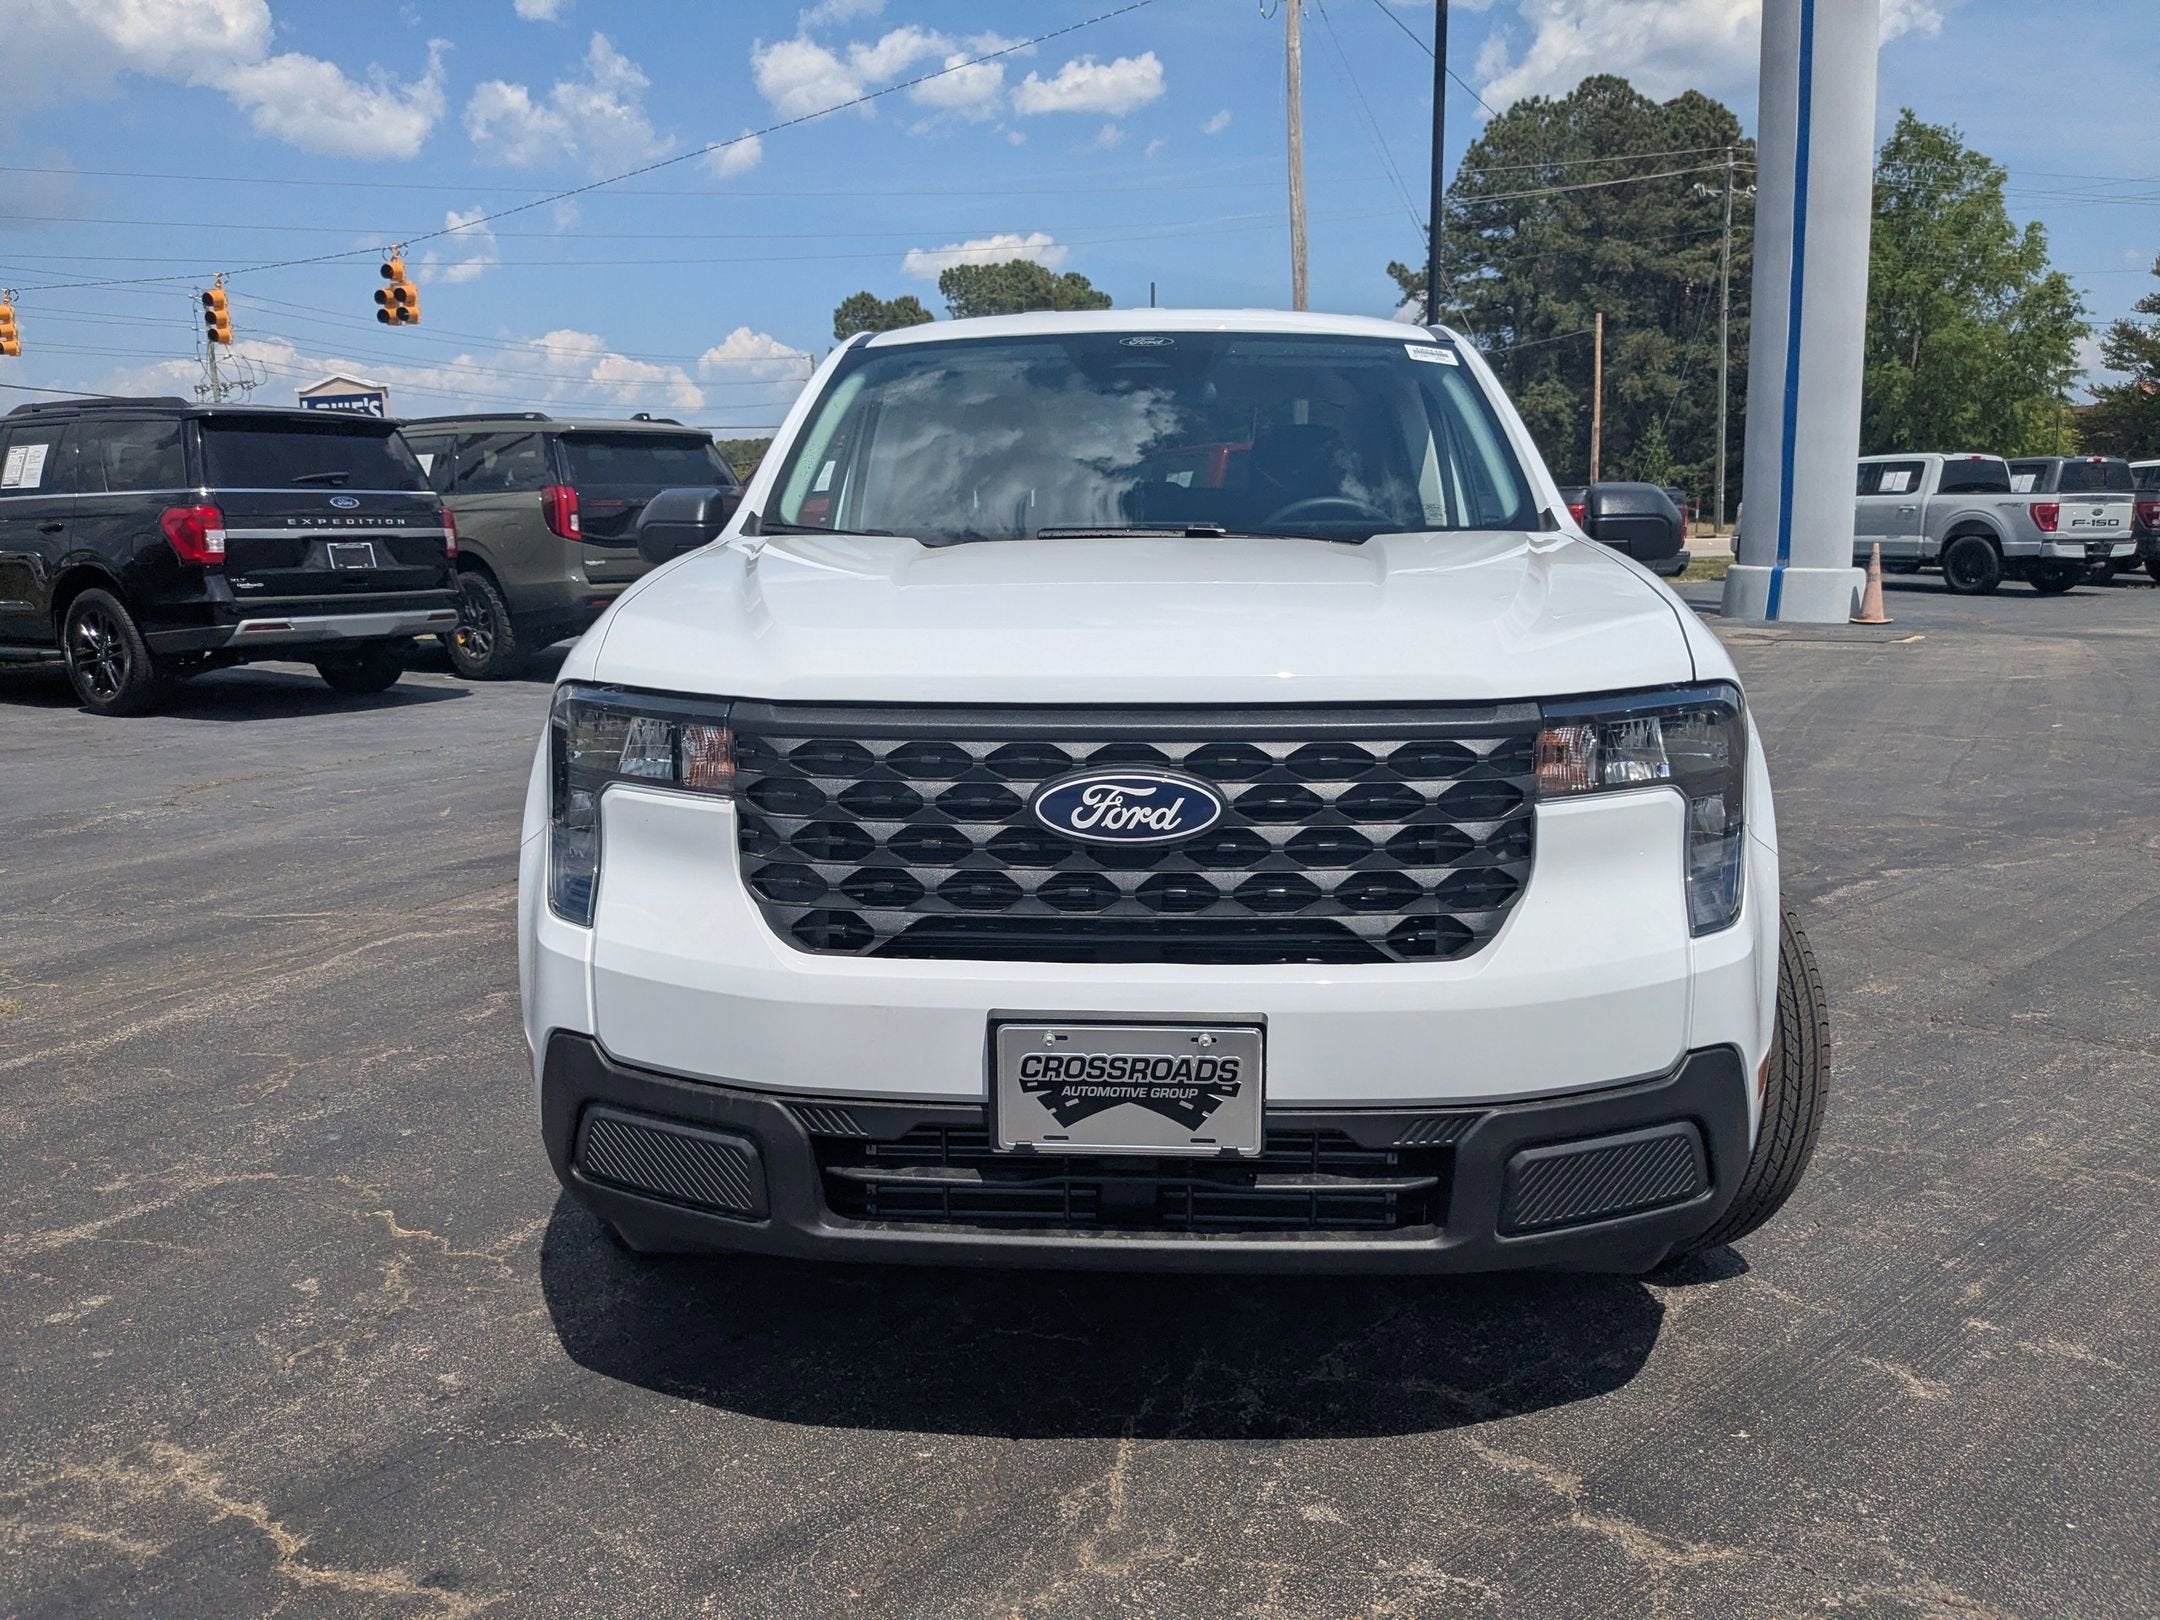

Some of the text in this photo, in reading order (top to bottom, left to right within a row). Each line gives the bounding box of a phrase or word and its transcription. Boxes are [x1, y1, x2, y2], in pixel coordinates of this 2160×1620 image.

[1128, 336, 1165, 346] Ford
[301, 397, 382, 418] E'S
[287, 518, 406, 526] EXPEDITION
[2071, 519, 2120, 527] F-150
[1071, 784, 1185, 831] Ford
[1020, 1055, 1241, 1083] CROSSROADS
[1061, 1085, 1199, 1099] AUTOMOTIVE GROUP
